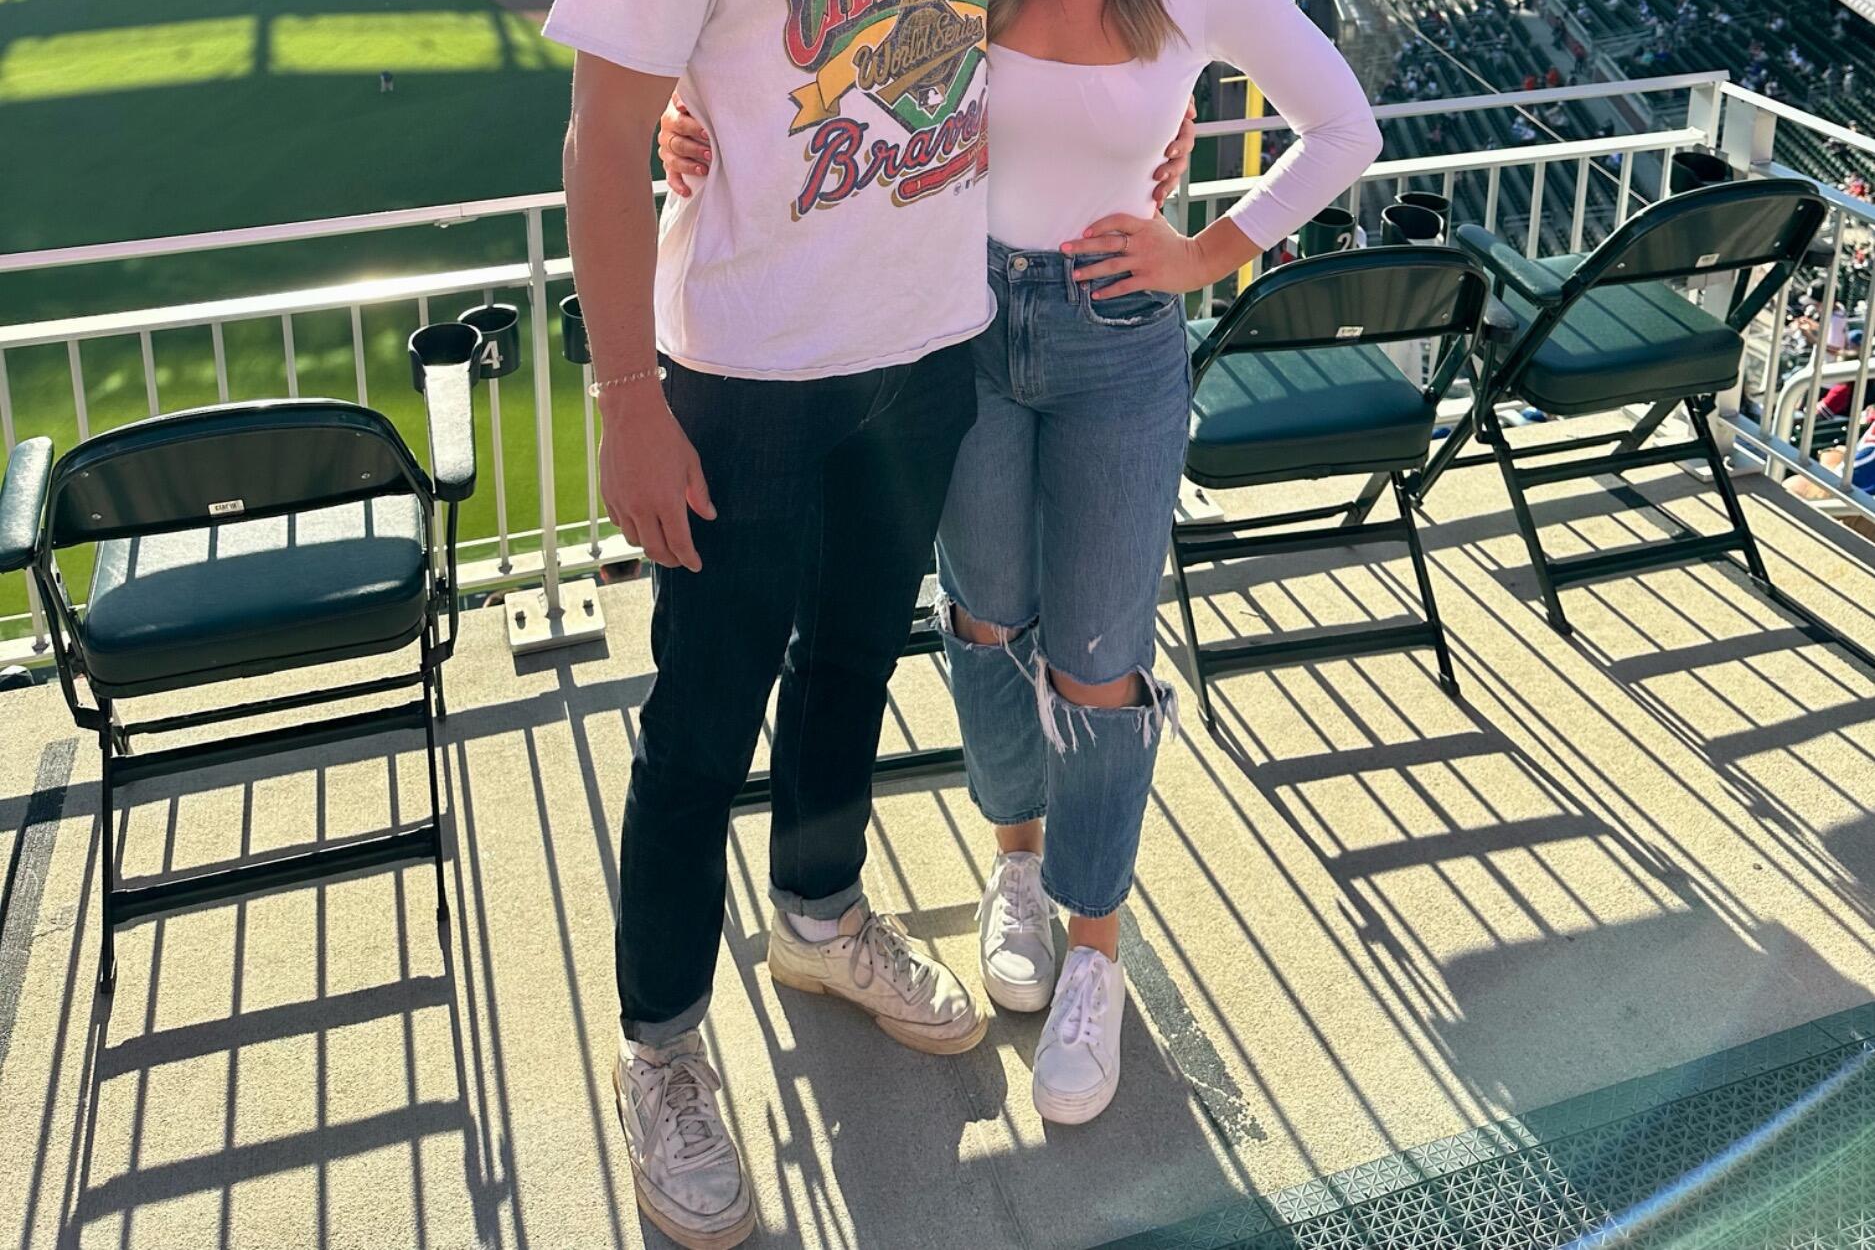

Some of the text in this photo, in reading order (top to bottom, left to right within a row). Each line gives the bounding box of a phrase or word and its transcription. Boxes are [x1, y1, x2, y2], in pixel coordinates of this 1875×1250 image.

[852, 13, 985, 90] World Series
[480, 340, 504, 370] 4
